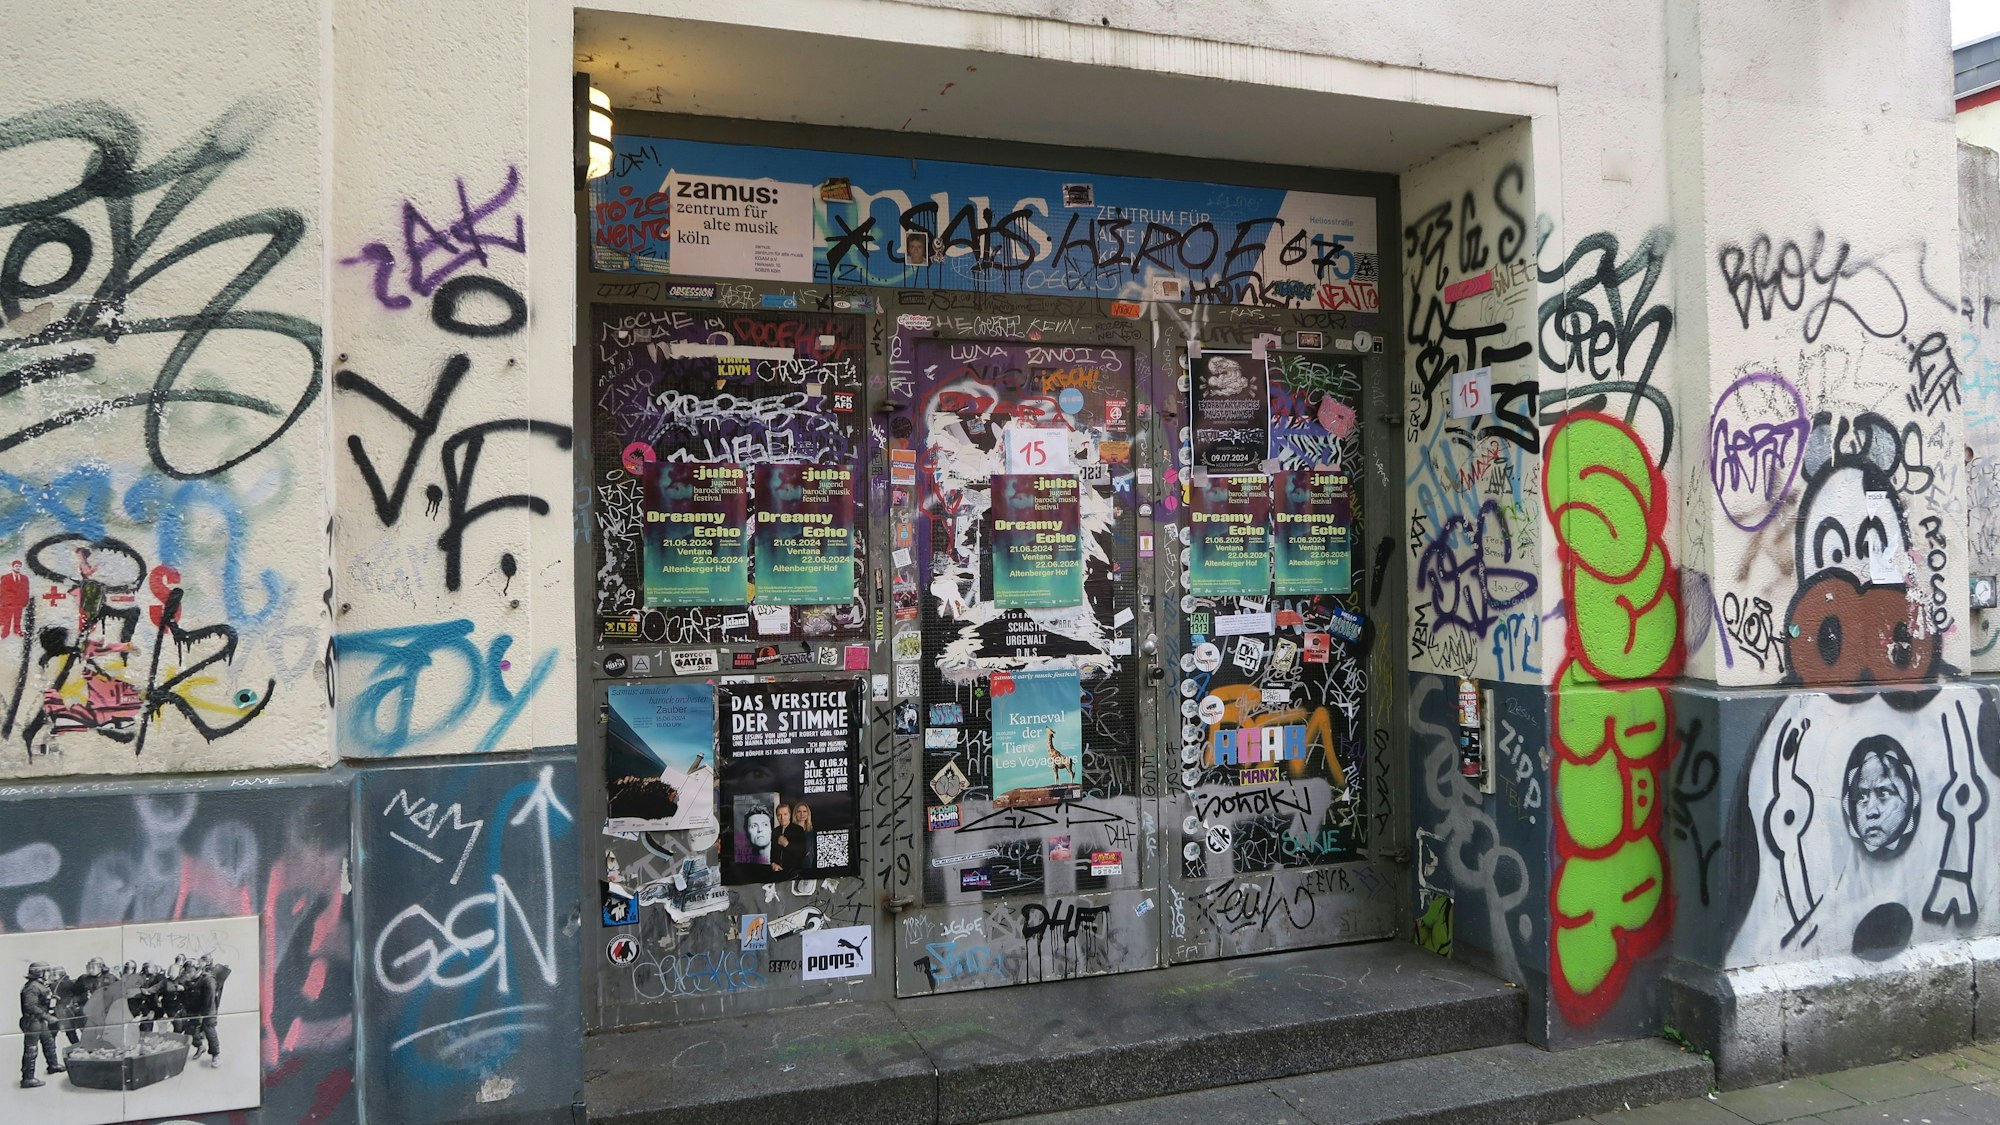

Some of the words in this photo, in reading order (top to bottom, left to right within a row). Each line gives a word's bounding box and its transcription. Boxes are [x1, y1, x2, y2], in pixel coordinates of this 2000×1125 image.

[677, 181, 778, 204] zamus:
[677, 203, 740, 217] zentrum
[744, 205, 768, 219] für
[1097, 205, 1174, 225] ZENTRUM
[1180, 209, 1210, 226] FÜR
[704, 218, 731, 231] alte
[735, 222, 778, 235] musik
[1309, 216, 1354, 227] Heliosstraße
[677, 230, 710, 245] köln
[1311, 233, 1355, 280] 15
[668, 285, 715, 298] OBSESSION
[950, 345, 1008, 364] LUNA
[718, 365, 751, 376] K.DYM
[1460, 380, 1480, 409] 15
[1020, 440, 1046, 466] 15
[693, 466, 743, 481] :juba
[802, 467, 851, 482] :juba
[819, 481, 843, 489] jugend
[1034, 477, 1077, 491] :juba
[693, 494, 721, 502] festival
[1049, 489, 1071, 497] jugend
[647, 510, 725, 524] Dreamy
[758, 511, 833, 525] Dreamy
[1192, 512, 1253, 524] Dreamy
[1277, 512, 1335, 524] Dreamy
[995, 520, 1063, 531] Dreamy
[1229, 526, 1265, 535] Echo
[1311, 526, 1346, 535] Echo
[693, 526, 741, 538] Echo
[803, 526, 848, 538] Echo
[1036, 533, 1076, 543] Echo
[663, 539, 713, 547] 21.06.2024
[663, 566, 713, 574] Altenberger
[1191, 613, 1209, 624] TAXI
[1191, 623, 1209, 634] 1313
[1006, 634, 1047, 646] URGEWALT
[675, 657, 712, 668] QATAR
[1053, 671, 1077, 679] festival
[731, 695, 763, 712] DAS
[771, 691, 847, 710] VERSTECK
[656, 706, 687, 714] Zauber
[732, 712, 768, 733] DER
[778, 709, 848, 732] STIMME
[1009, 711, 1065, 725] Karneval
[1022, 727, 1042, 739] der
[1002, 742, 1035, 754] Tiere
[804, 760, 817, 769] SA.
[820, 758, 848, 768] 01.06.24
[996, 758, 1016, 769] Les
[1019, 755, 1078, 768] Voyageurs
[804, 769, 823, 778] BLUE
[826, 767, 848, 777] SHELL
[1241, 769, 1278, 784] MANX
[804, 778, 826, 786] EINLASS
[804, 785, 826, 793] BEGINN
